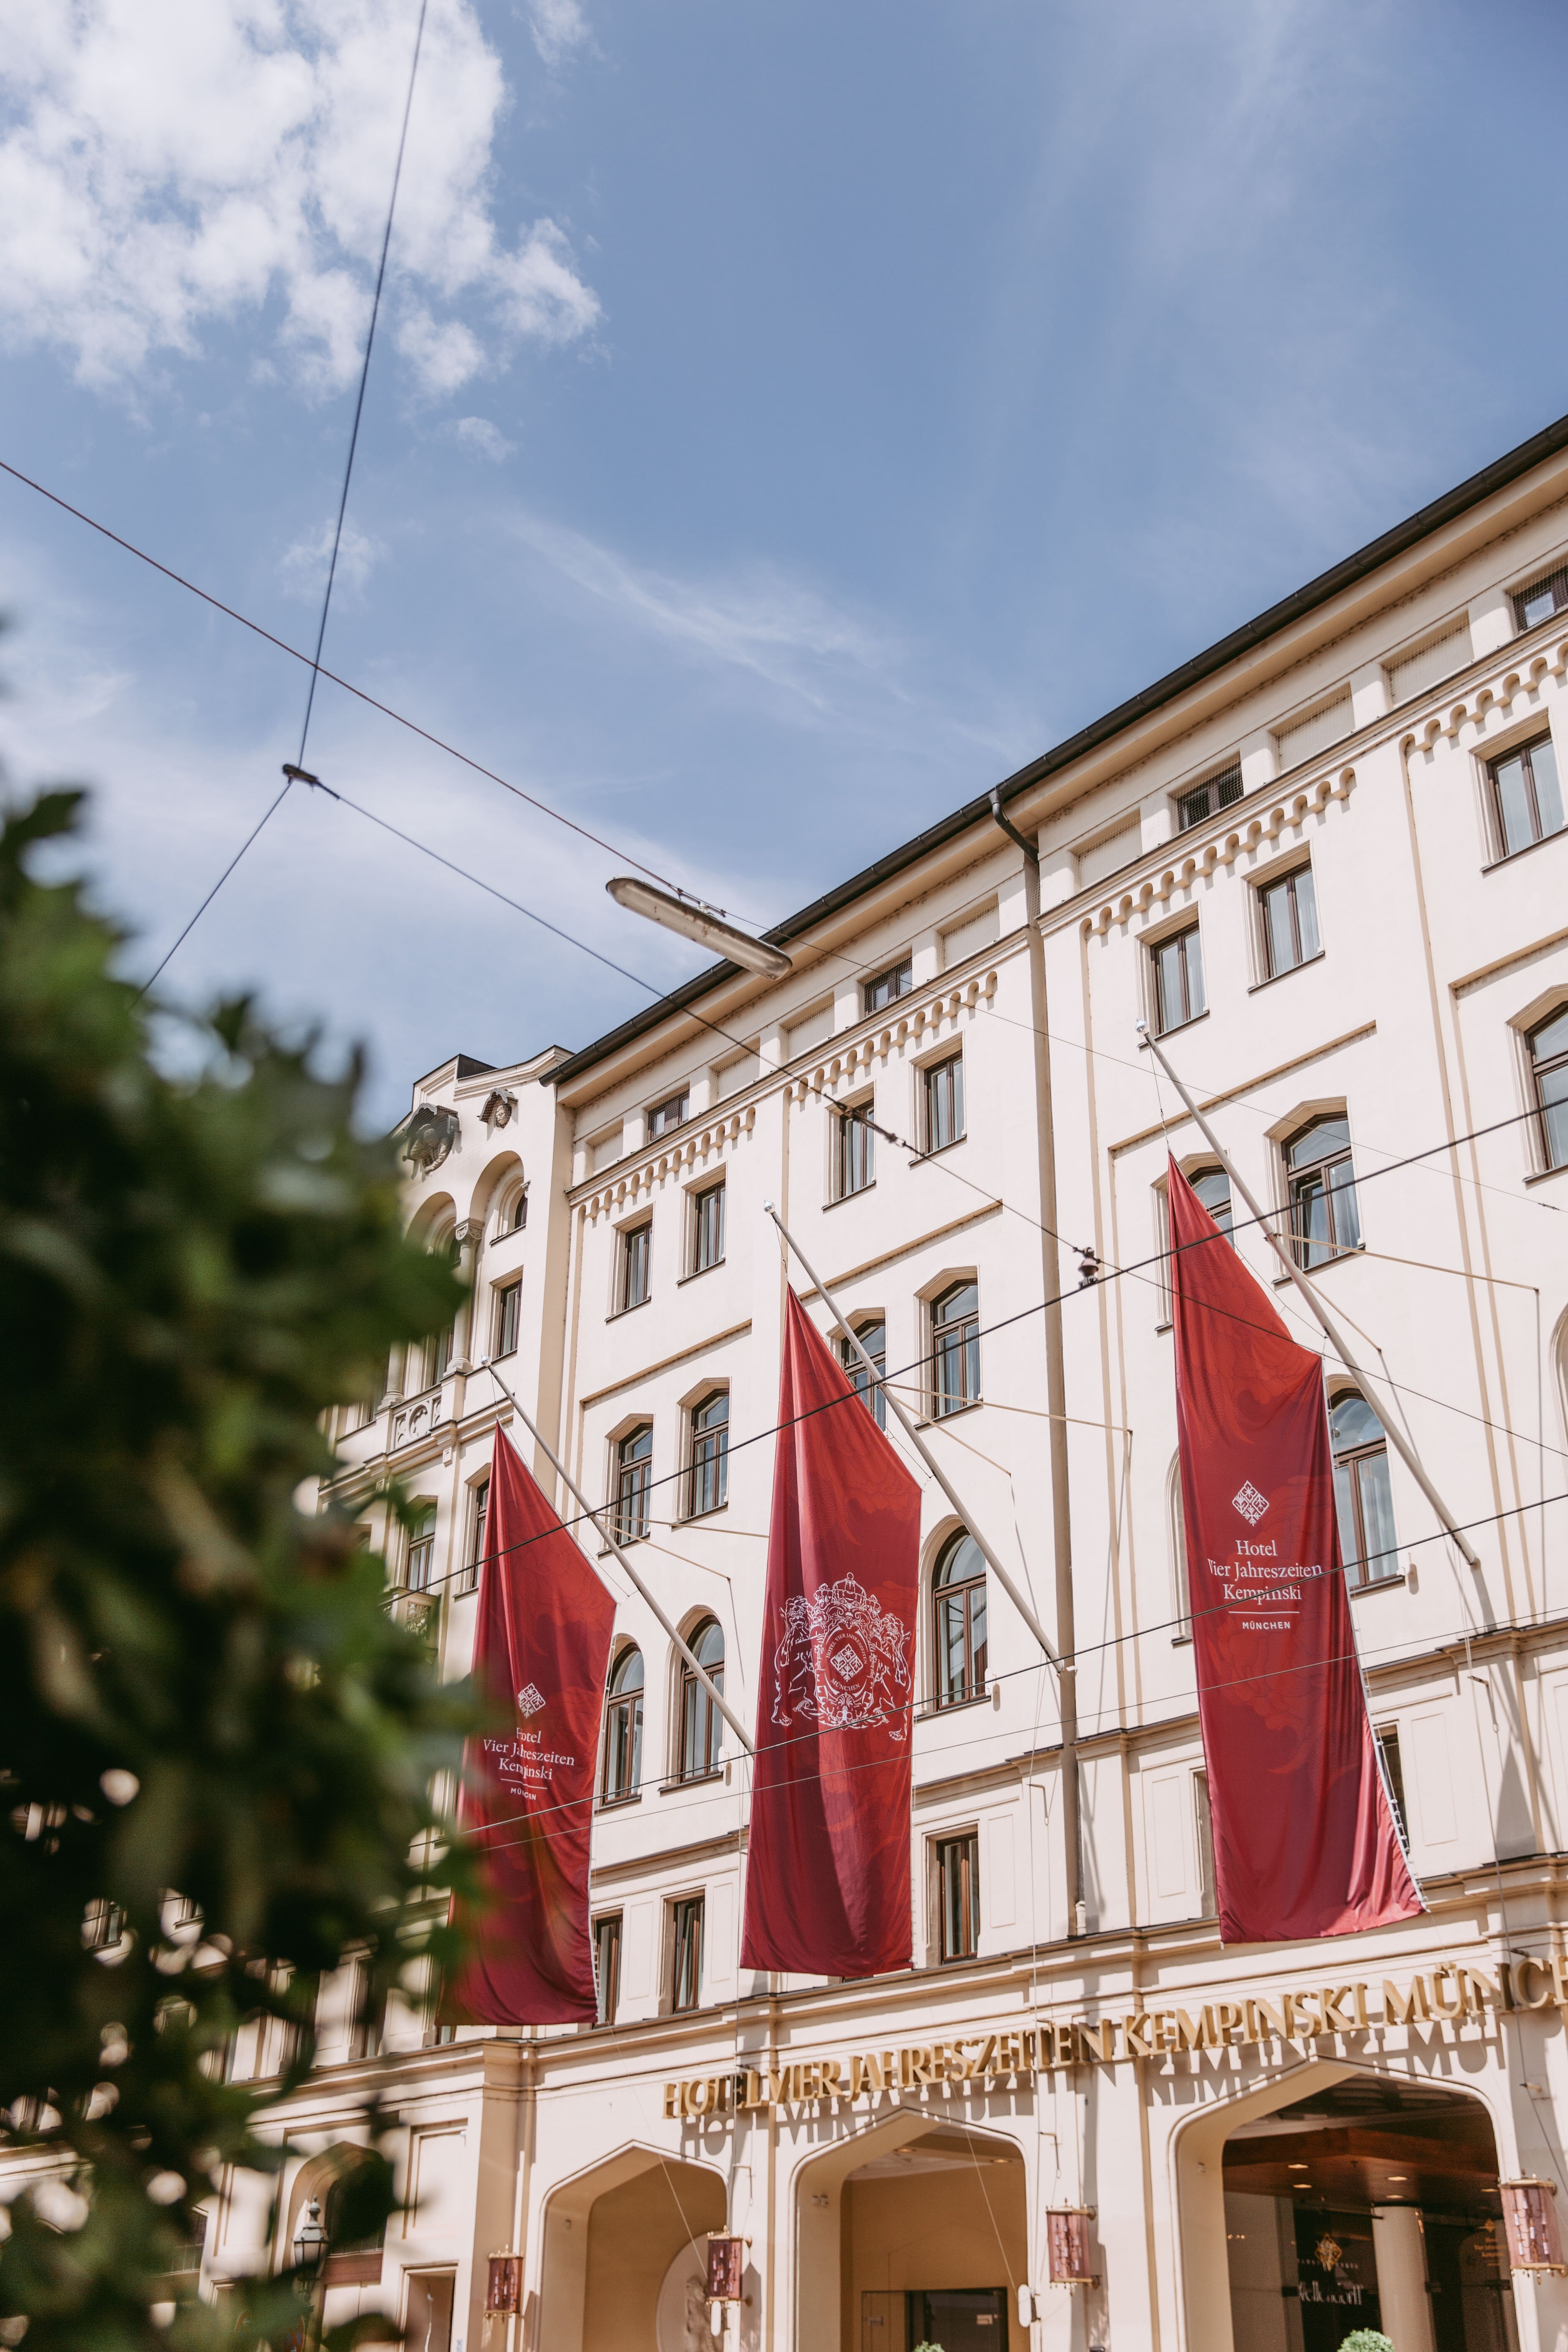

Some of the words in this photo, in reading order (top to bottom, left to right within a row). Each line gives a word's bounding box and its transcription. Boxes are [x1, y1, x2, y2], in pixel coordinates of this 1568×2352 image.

[1235, 1540, 1278, 1556] Hotel
[1207, 1559, 1230, 1576] Vier
[1234, 1561, 1323, 1582] Jahreszeiten
[1223, 1584, 1302, 1605] Kempinski
[1242, 1621, 1290, 1630] MÜNCHEN
[826, 1641, 836, 1658] HOTEL
[846, 1633, 867, 1664] JAHRESZEITEN
[831, 1678, 860, 1691] MÜNCHEN
[516, 1727, 541, 1743] Hotel
[483, 1739, 509, 1753] Vier
[511, 1787, 536, 1800] MÜCEN
[662, 2069, 769, 2119] HOTEL
[766, 2060, 846, 2104] VIER
[844, 2019, 1113, 2103] JAHRESZEITEN
[1120, 1983, 1369, 2059] KEMPINSKI
